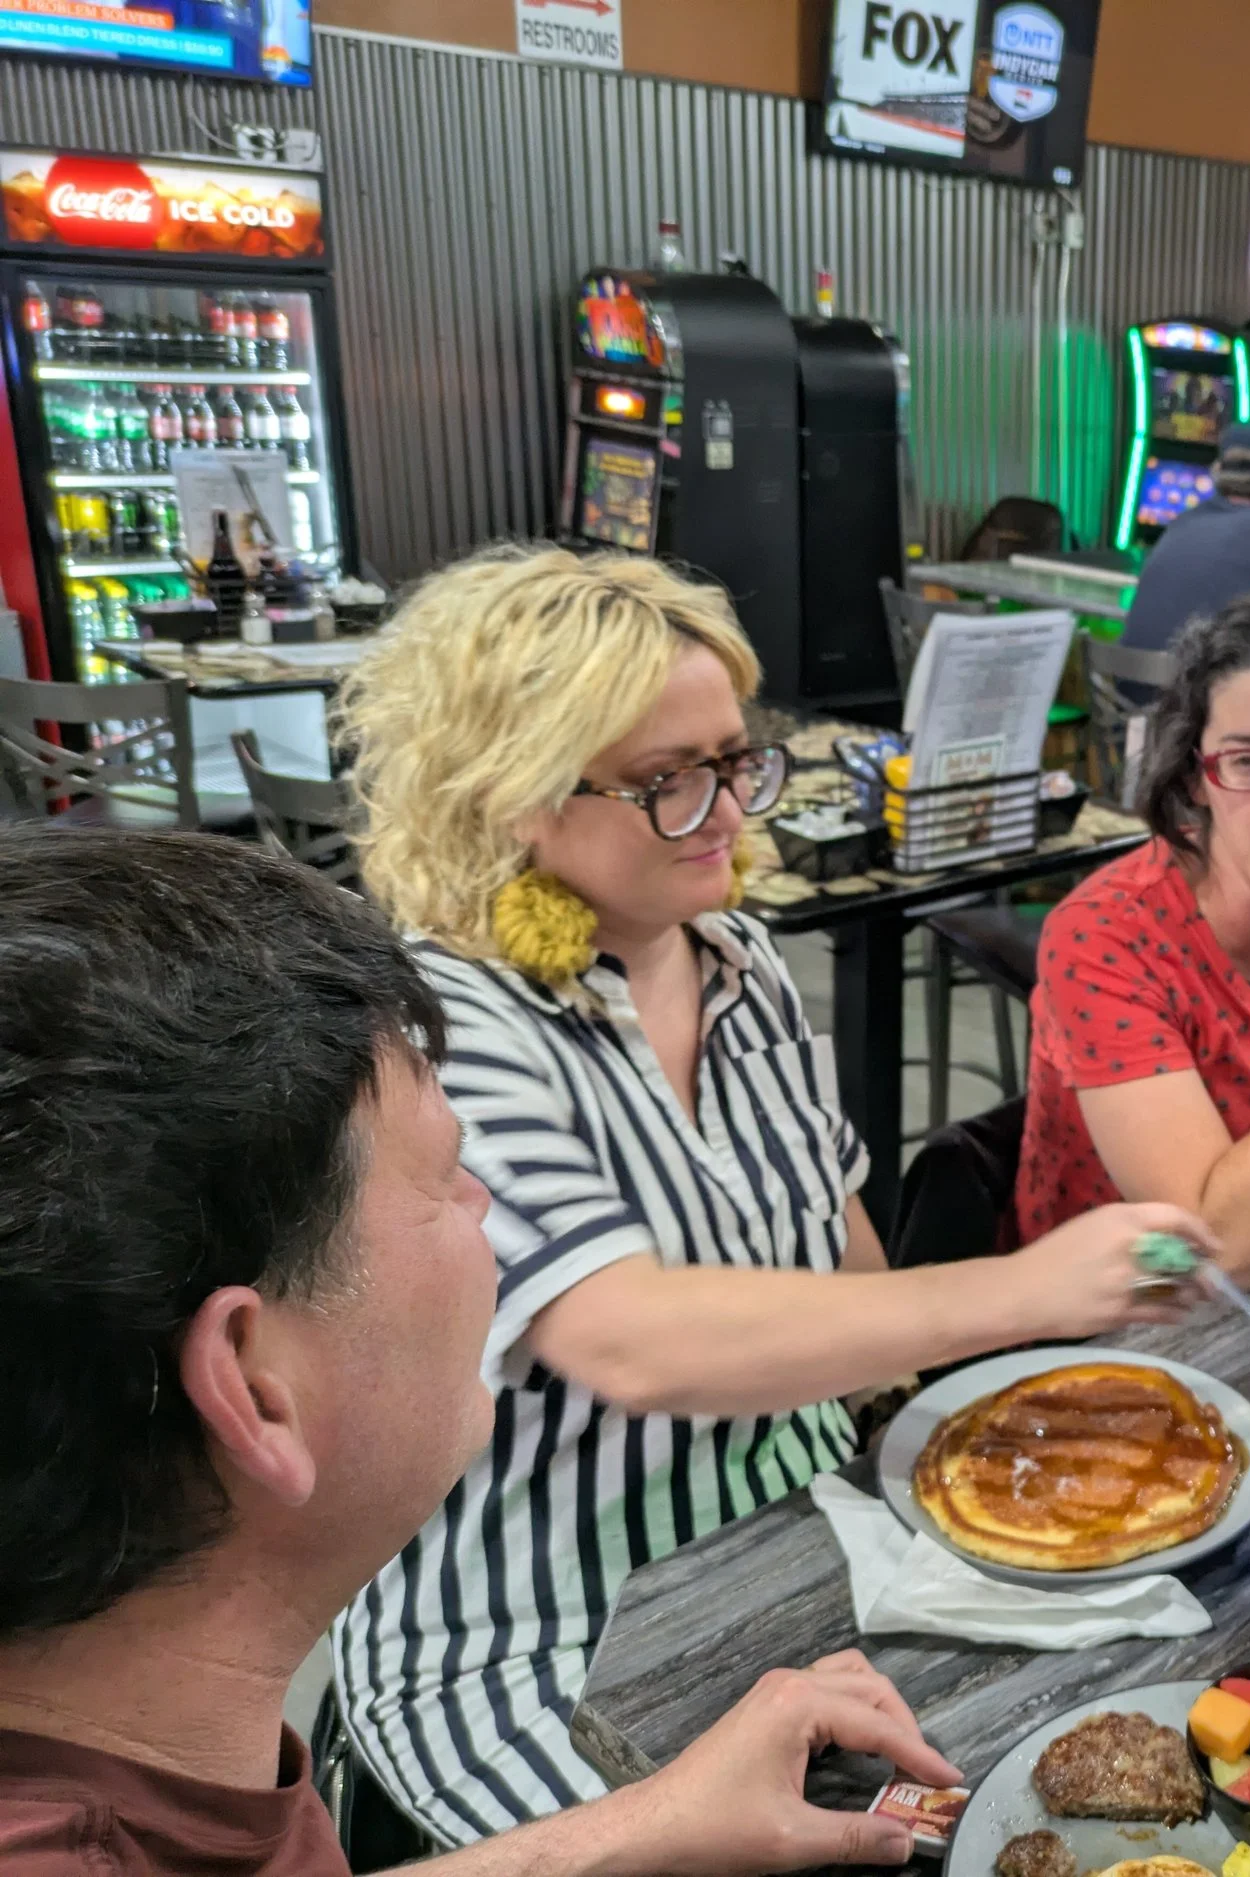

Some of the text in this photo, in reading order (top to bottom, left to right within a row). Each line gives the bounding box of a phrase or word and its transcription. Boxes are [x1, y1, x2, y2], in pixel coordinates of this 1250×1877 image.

[522, 18, 620, 60] RESTROOMS
[861, 2, 965, 77] FOX
[1023, 29, 1054, 49] NTT
[168, 199, 295, 229] ICE COLD
[886, 1784, 923, 1808] JAM
